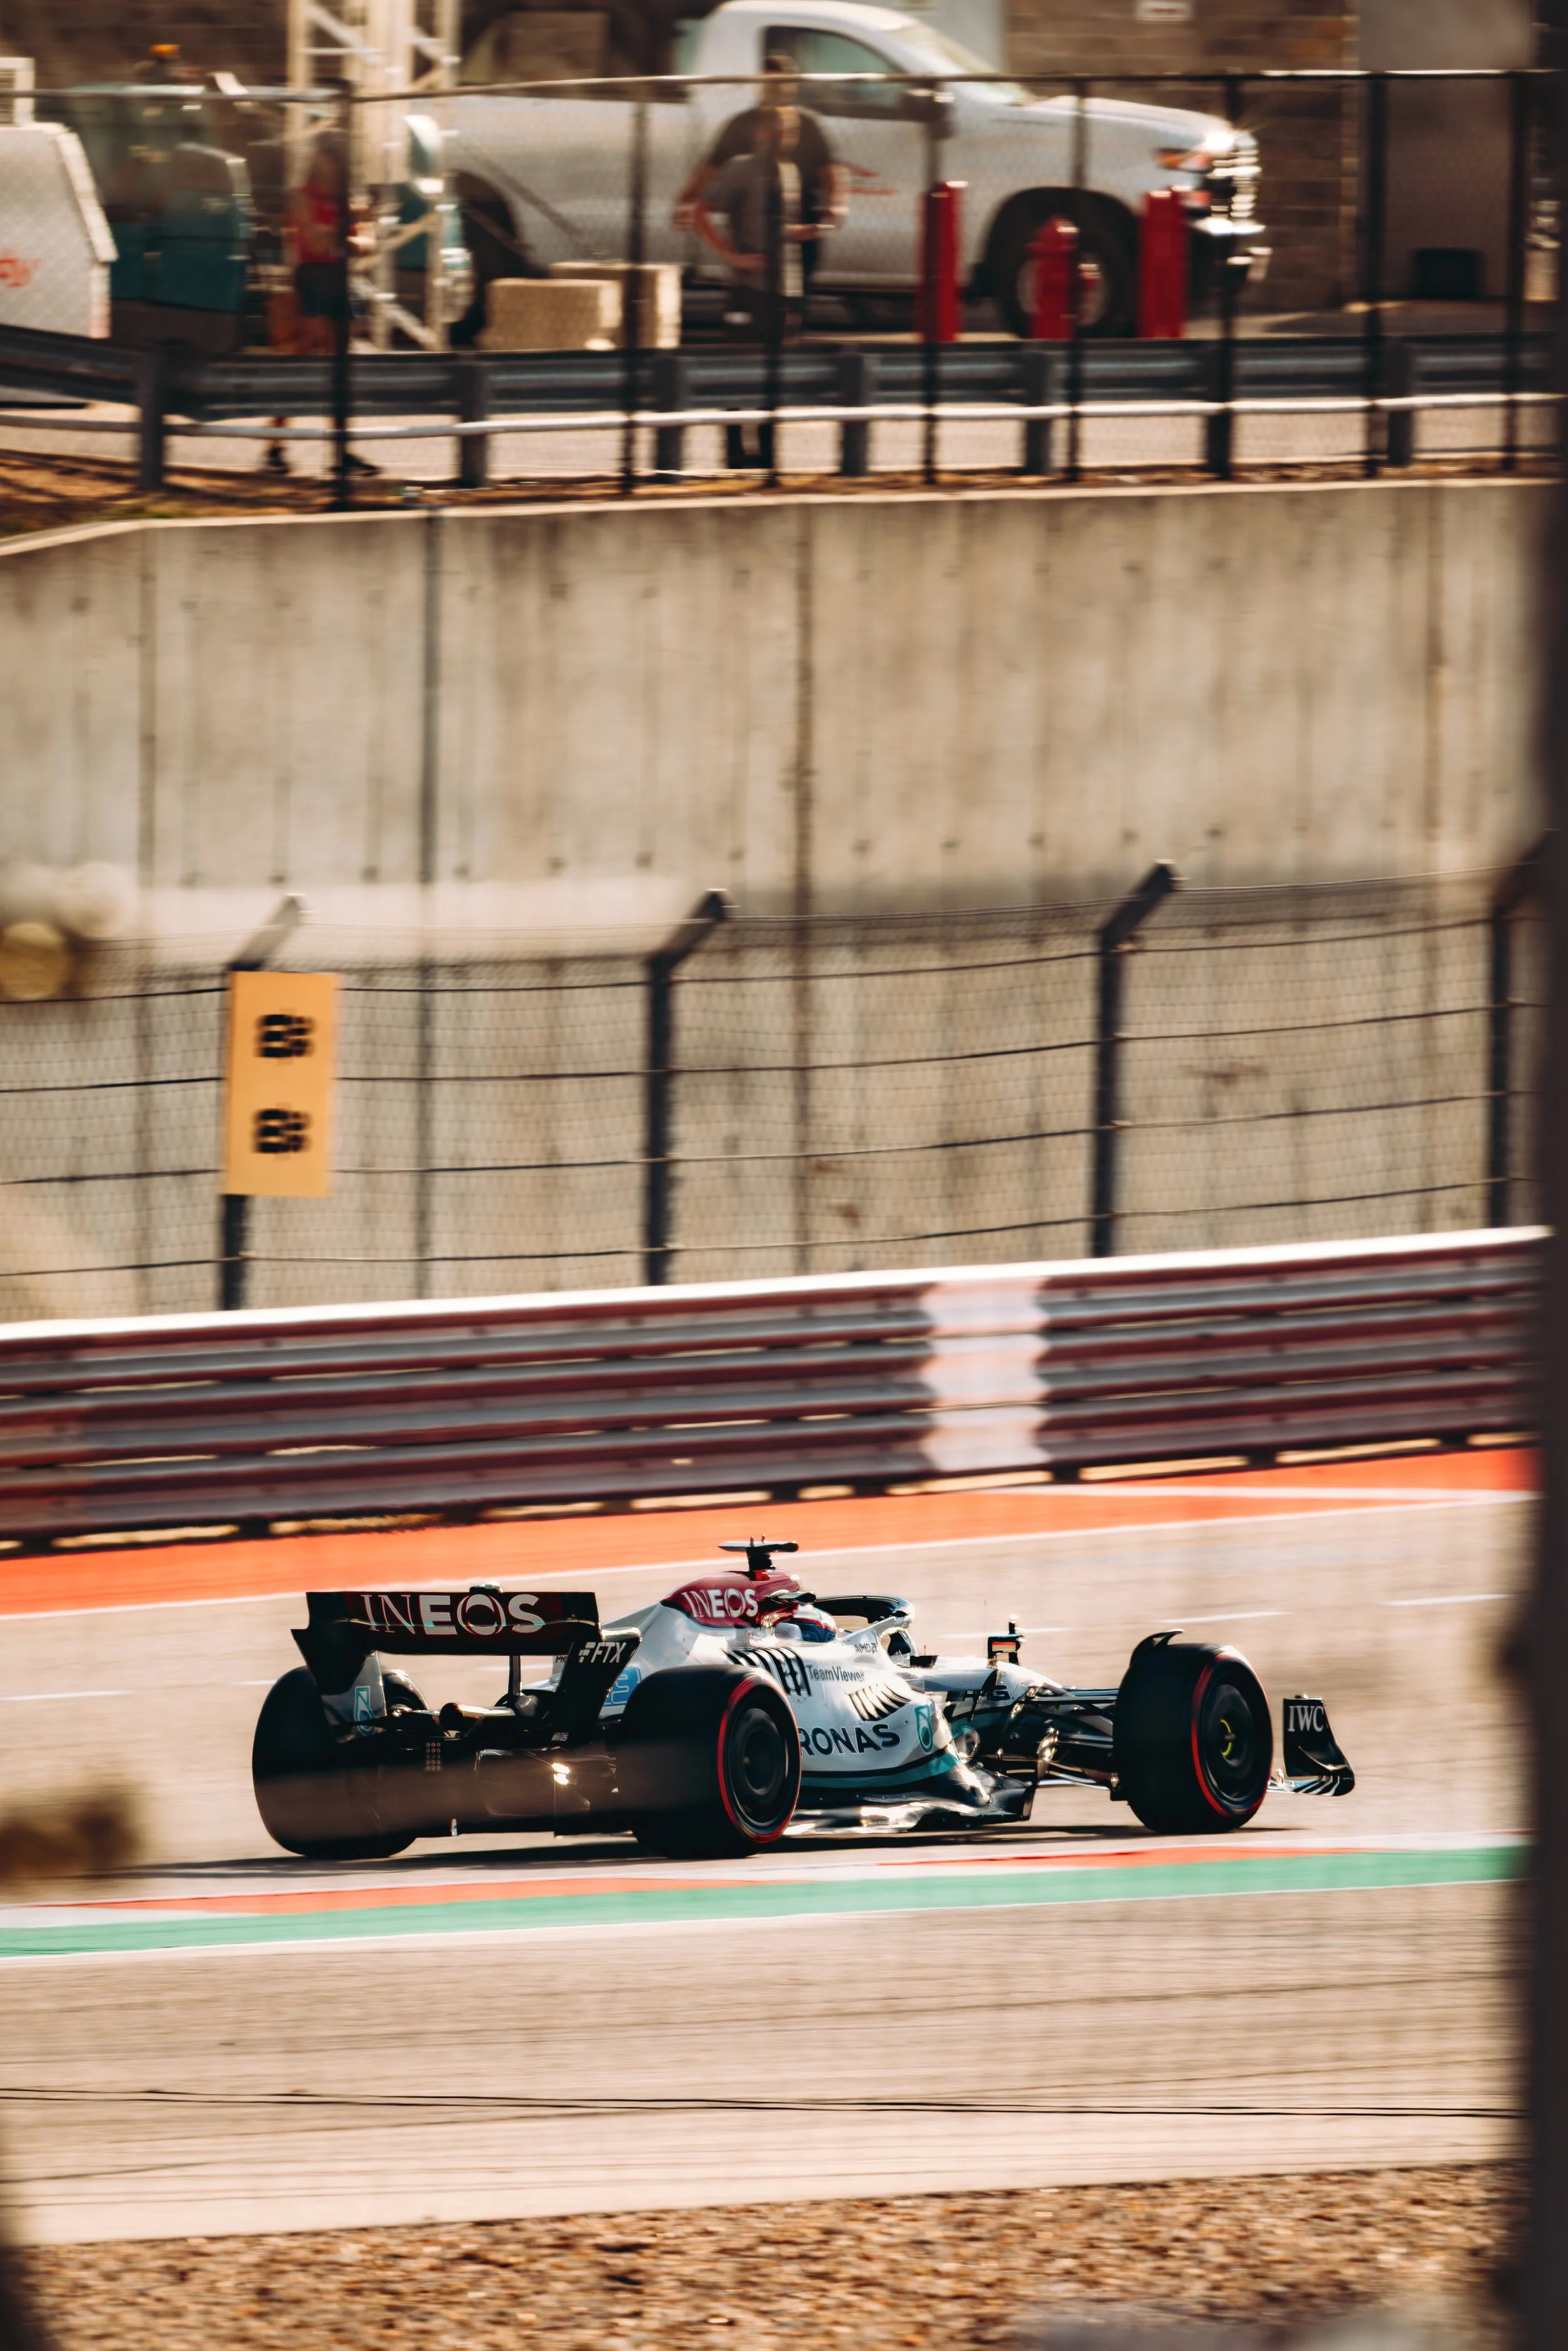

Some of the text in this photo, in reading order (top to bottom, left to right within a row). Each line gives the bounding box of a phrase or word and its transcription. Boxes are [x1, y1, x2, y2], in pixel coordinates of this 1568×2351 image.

[361, 1594, 544, 1635] INEOS
[681, 1588, 758, 1618] INEOS
[591, 1642, 626, 1663] FTX
[805, 1665, 864, 1681] TeamViewer
[1287, 1705, 1324, 1733] IWC
[798, 1724, 901, 1756] RONAS
